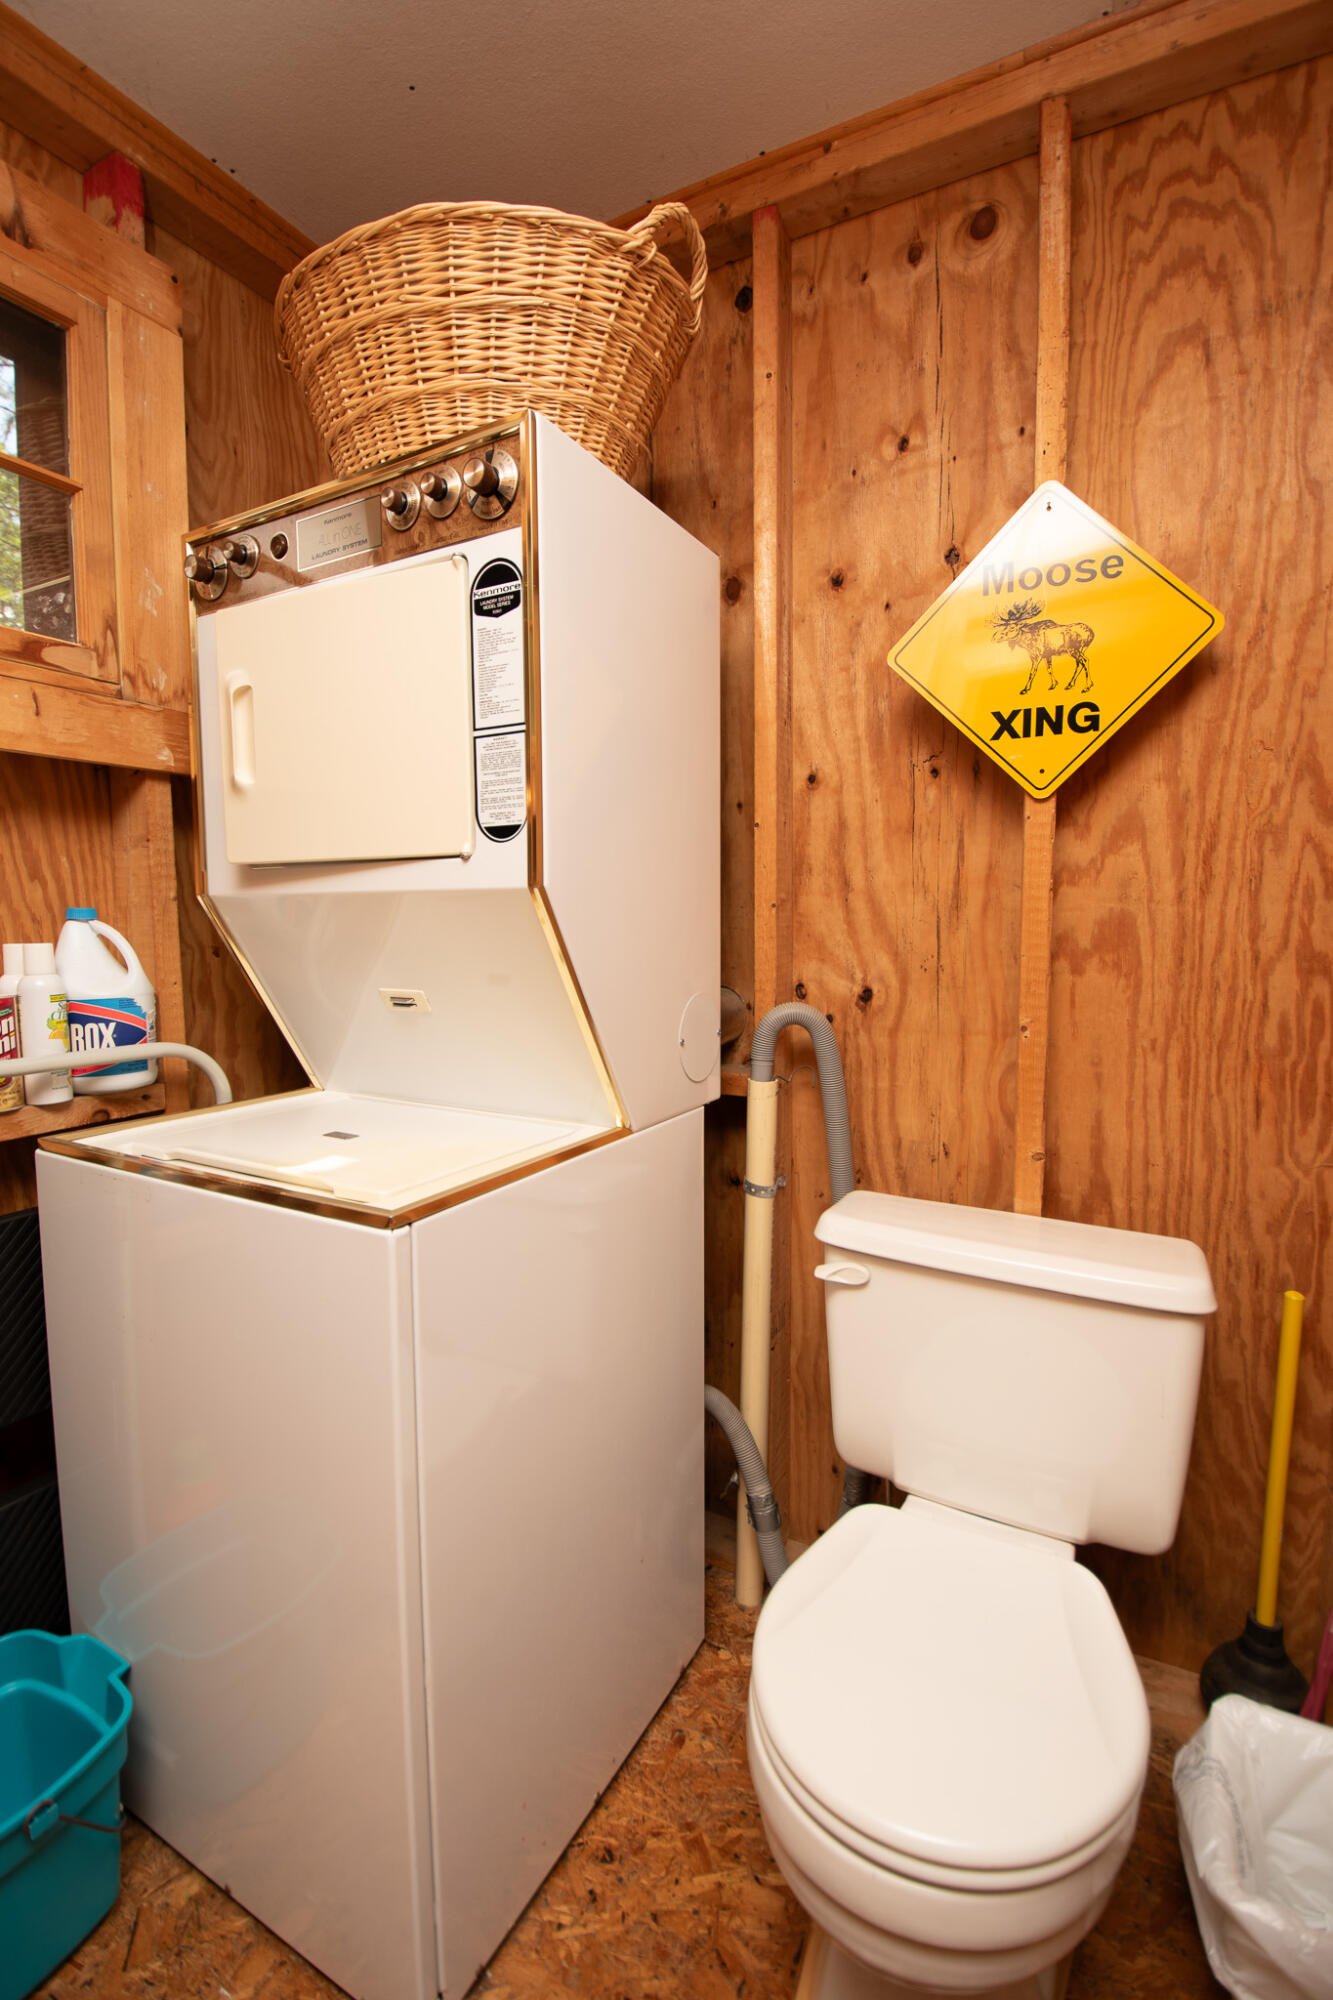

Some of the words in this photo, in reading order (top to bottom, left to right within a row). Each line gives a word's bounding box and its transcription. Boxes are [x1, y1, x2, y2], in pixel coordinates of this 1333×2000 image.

[312, 546, 341, 560] LAUNDRY
[342, 538, 368, 551] SYSTEM
[473, 583, 521, 599] Kenmore
[982, 554, 1124, 597] Moose
[990, 701, 1101, 741] XING
